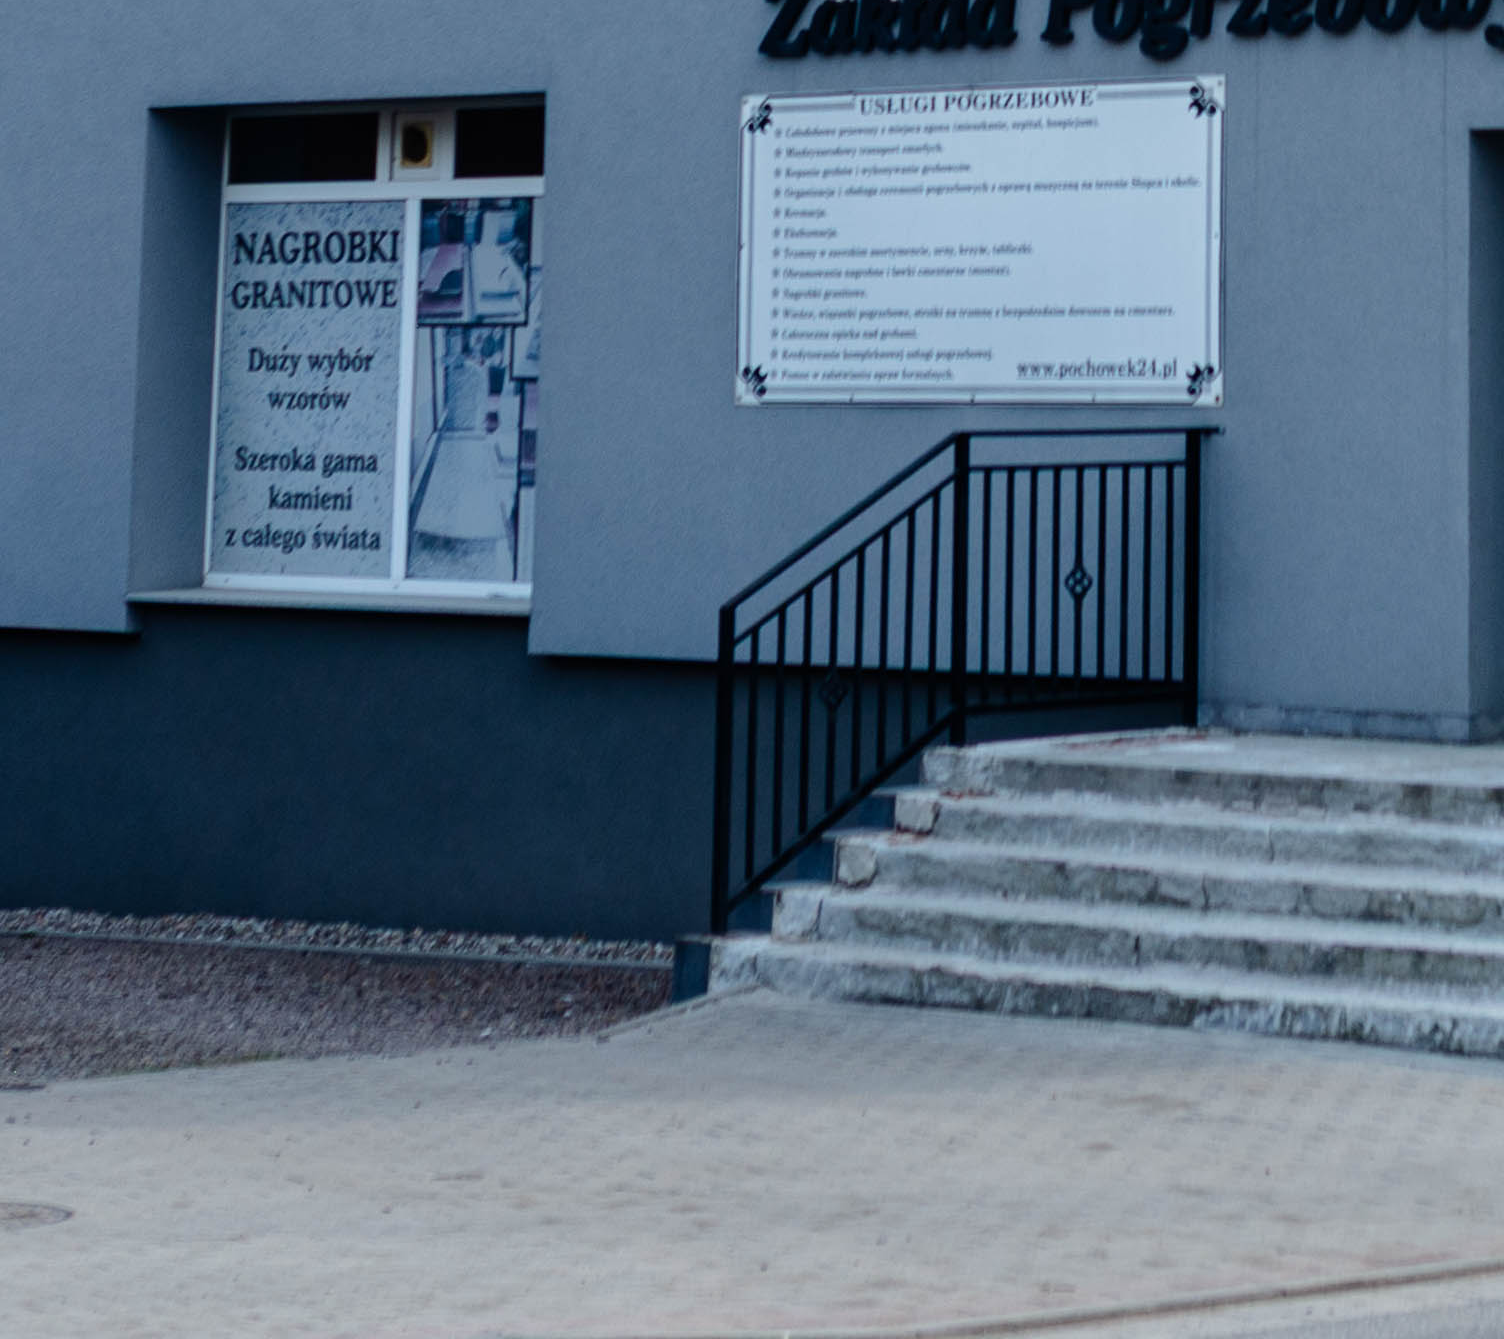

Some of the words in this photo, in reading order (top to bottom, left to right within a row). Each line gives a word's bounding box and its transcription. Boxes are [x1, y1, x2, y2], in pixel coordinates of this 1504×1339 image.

[860, 94, 936, 116] USŁUGI
[944, 89, 1095, 111] POGRZEBOWE
[233, 228, 400, 265] NAGROBKI
[230, 279, 397, 310] GRANITOWE
[248, 344, 301, 377] Duży
[308, 349, 374, 375] wybór
[1017, 357, 1177, 379] www.pochowek24.pl
[268, 388, 350, 411] wzorów
[234, 445, 316, 473] Szeroka
[321, 454, 378, 479] gama
[268, 484, 352, 512] kamieni
[225, 530, 238, 548] z
[241, 526, 306, 555] całego
[312, 522, 381, 551] świata
